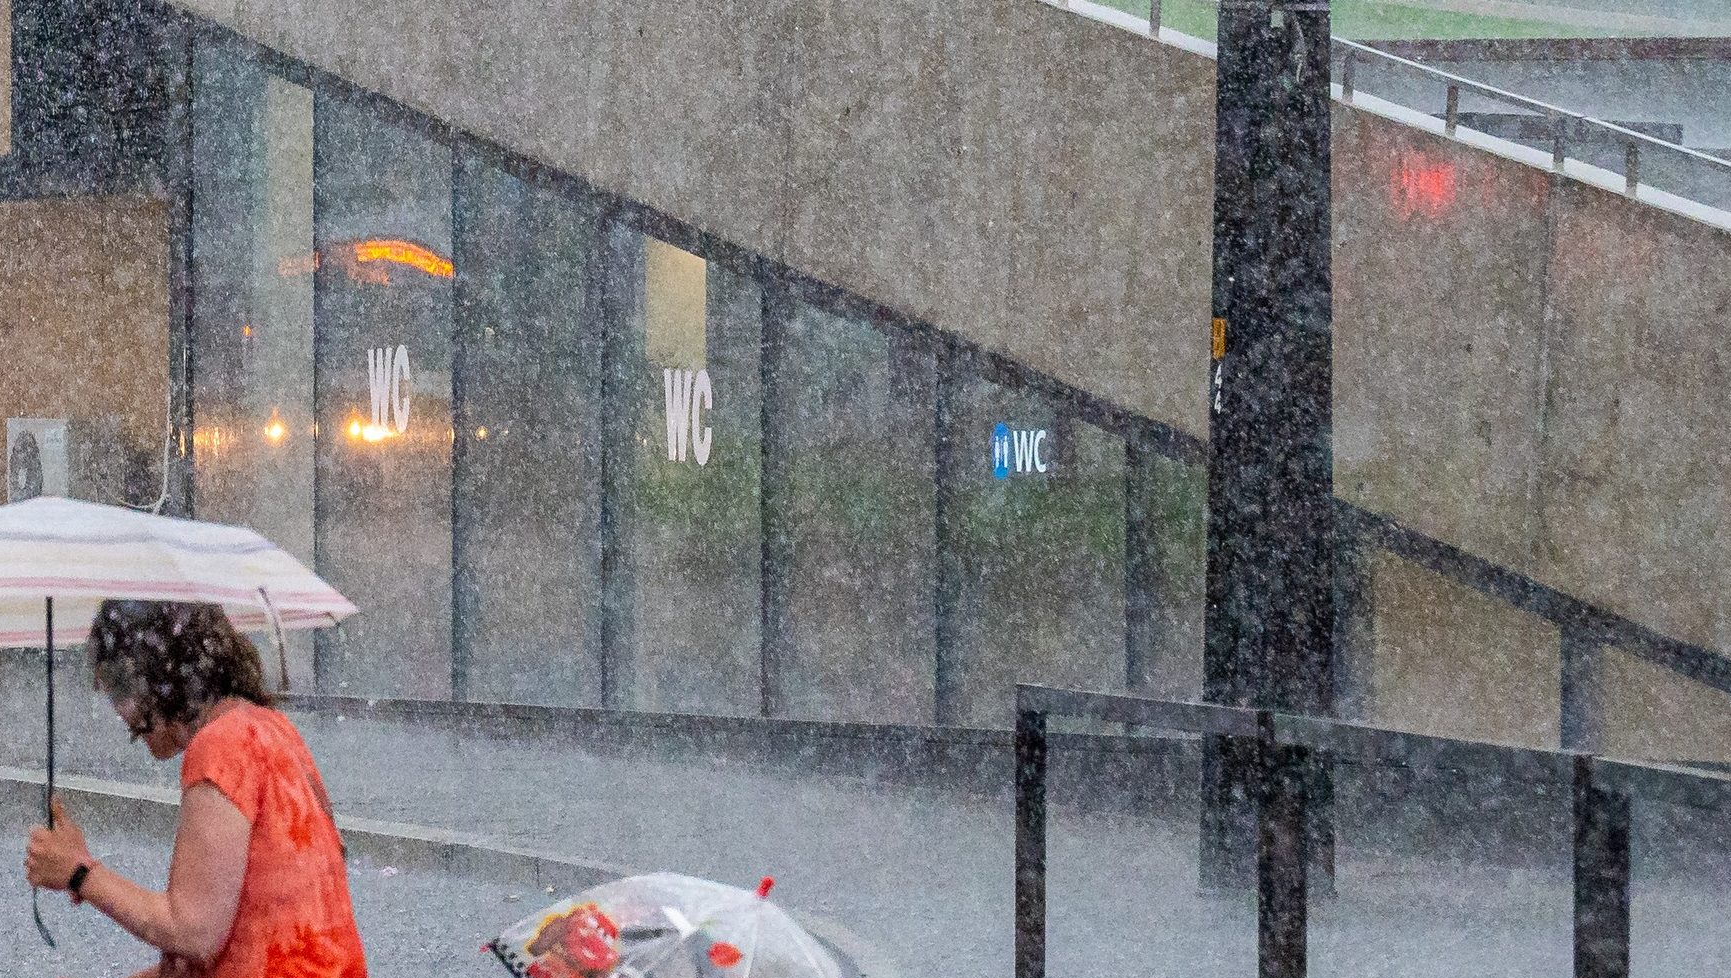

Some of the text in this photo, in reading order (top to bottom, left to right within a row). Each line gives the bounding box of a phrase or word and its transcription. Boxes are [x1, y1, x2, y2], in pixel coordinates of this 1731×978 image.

[367, 344, 411, 433] WC
[663, 367, 713, 466] WC
[1012, 429, 1047, 473] WC
